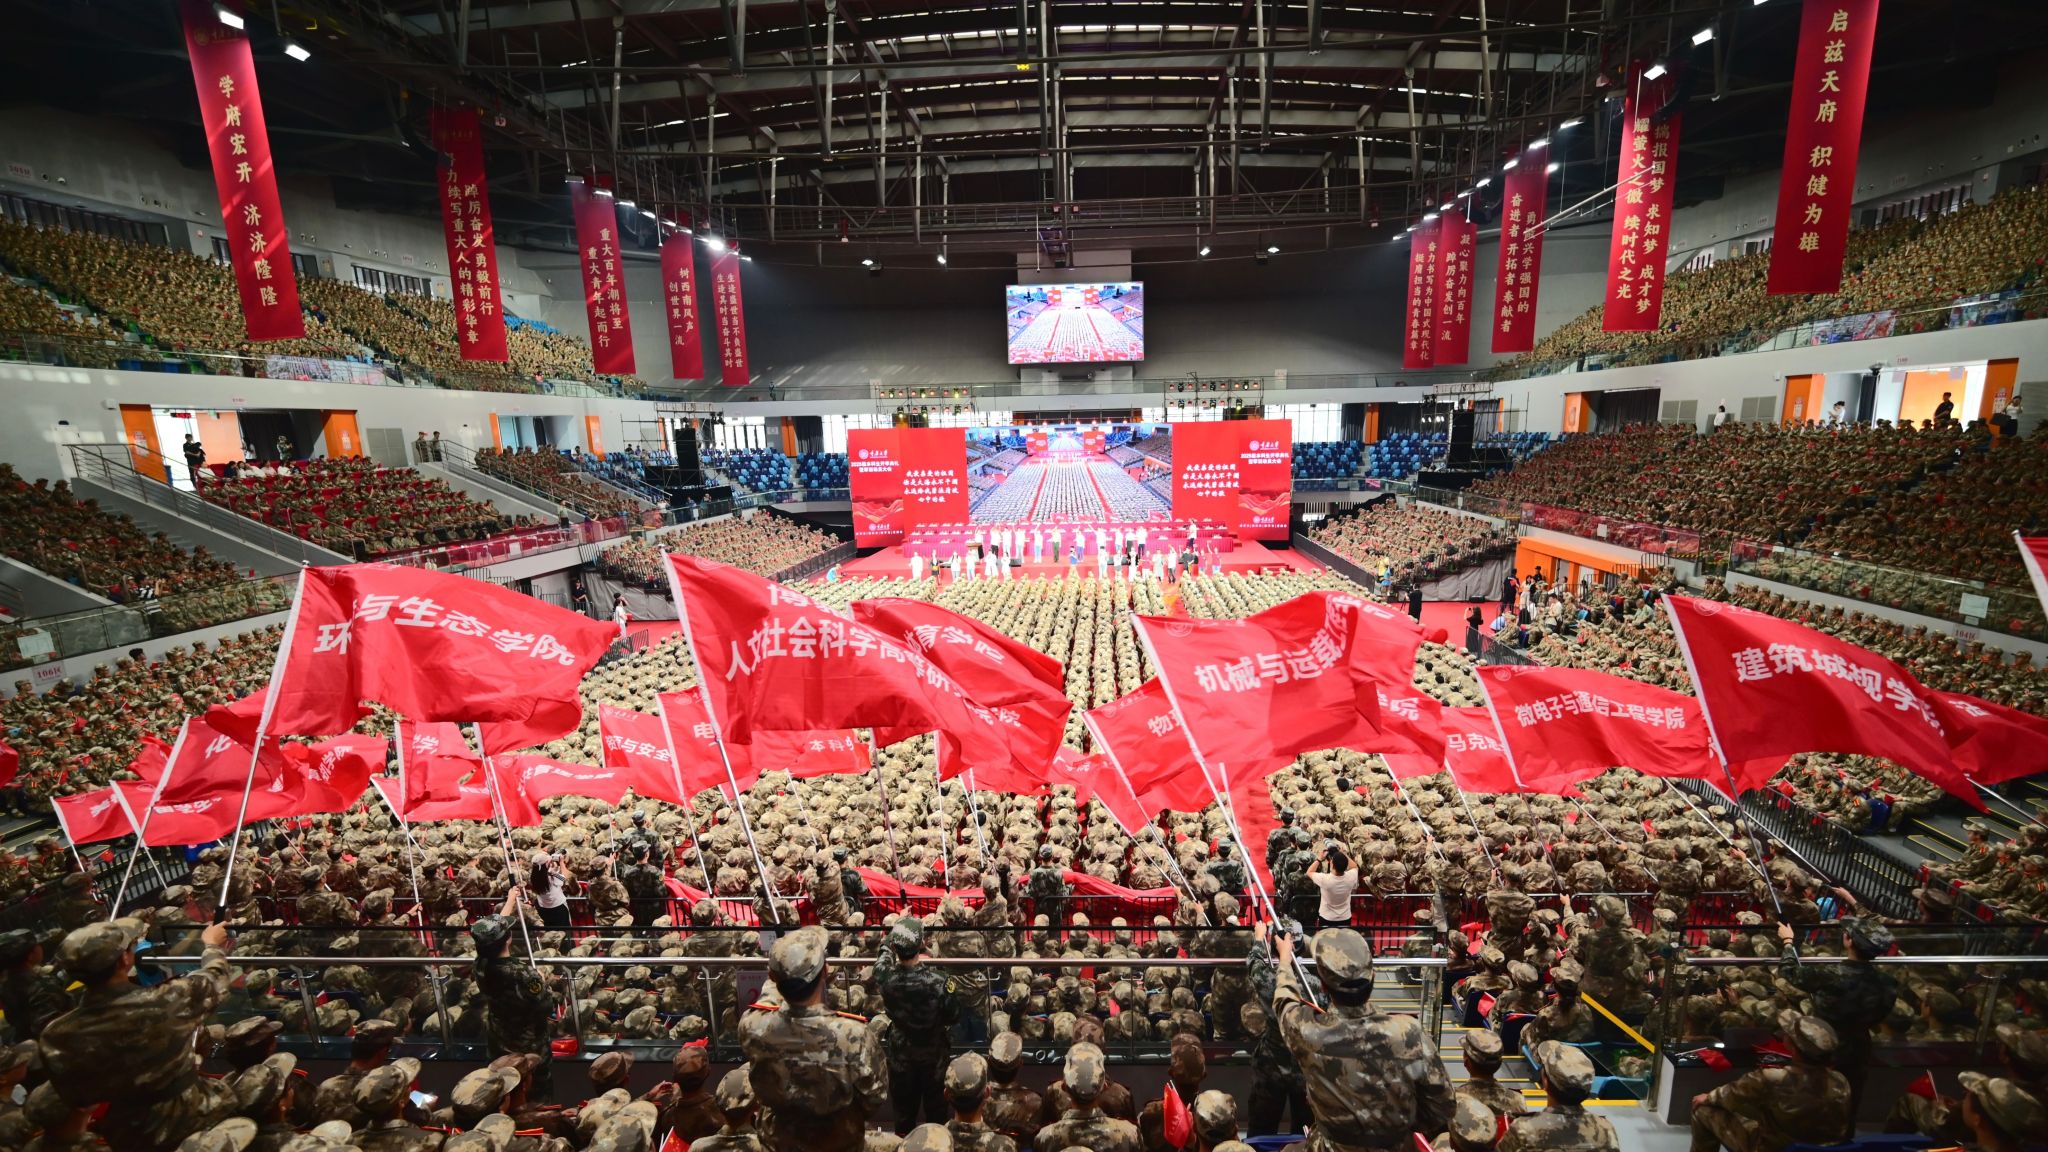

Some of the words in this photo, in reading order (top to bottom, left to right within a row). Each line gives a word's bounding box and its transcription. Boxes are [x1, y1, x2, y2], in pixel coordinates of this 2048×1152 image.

[218, 75, 252, 184] 学府宏开
[243, 204, 278, 307] 济济隆隆
[1798, 145, 1833, 253] 积健为雄
[587, 247, 611, 348] 重大青年起而行
[599, 229, 624, 330] 重大百年潮将至
[312, 593, 576, 666] 环与生态学院
